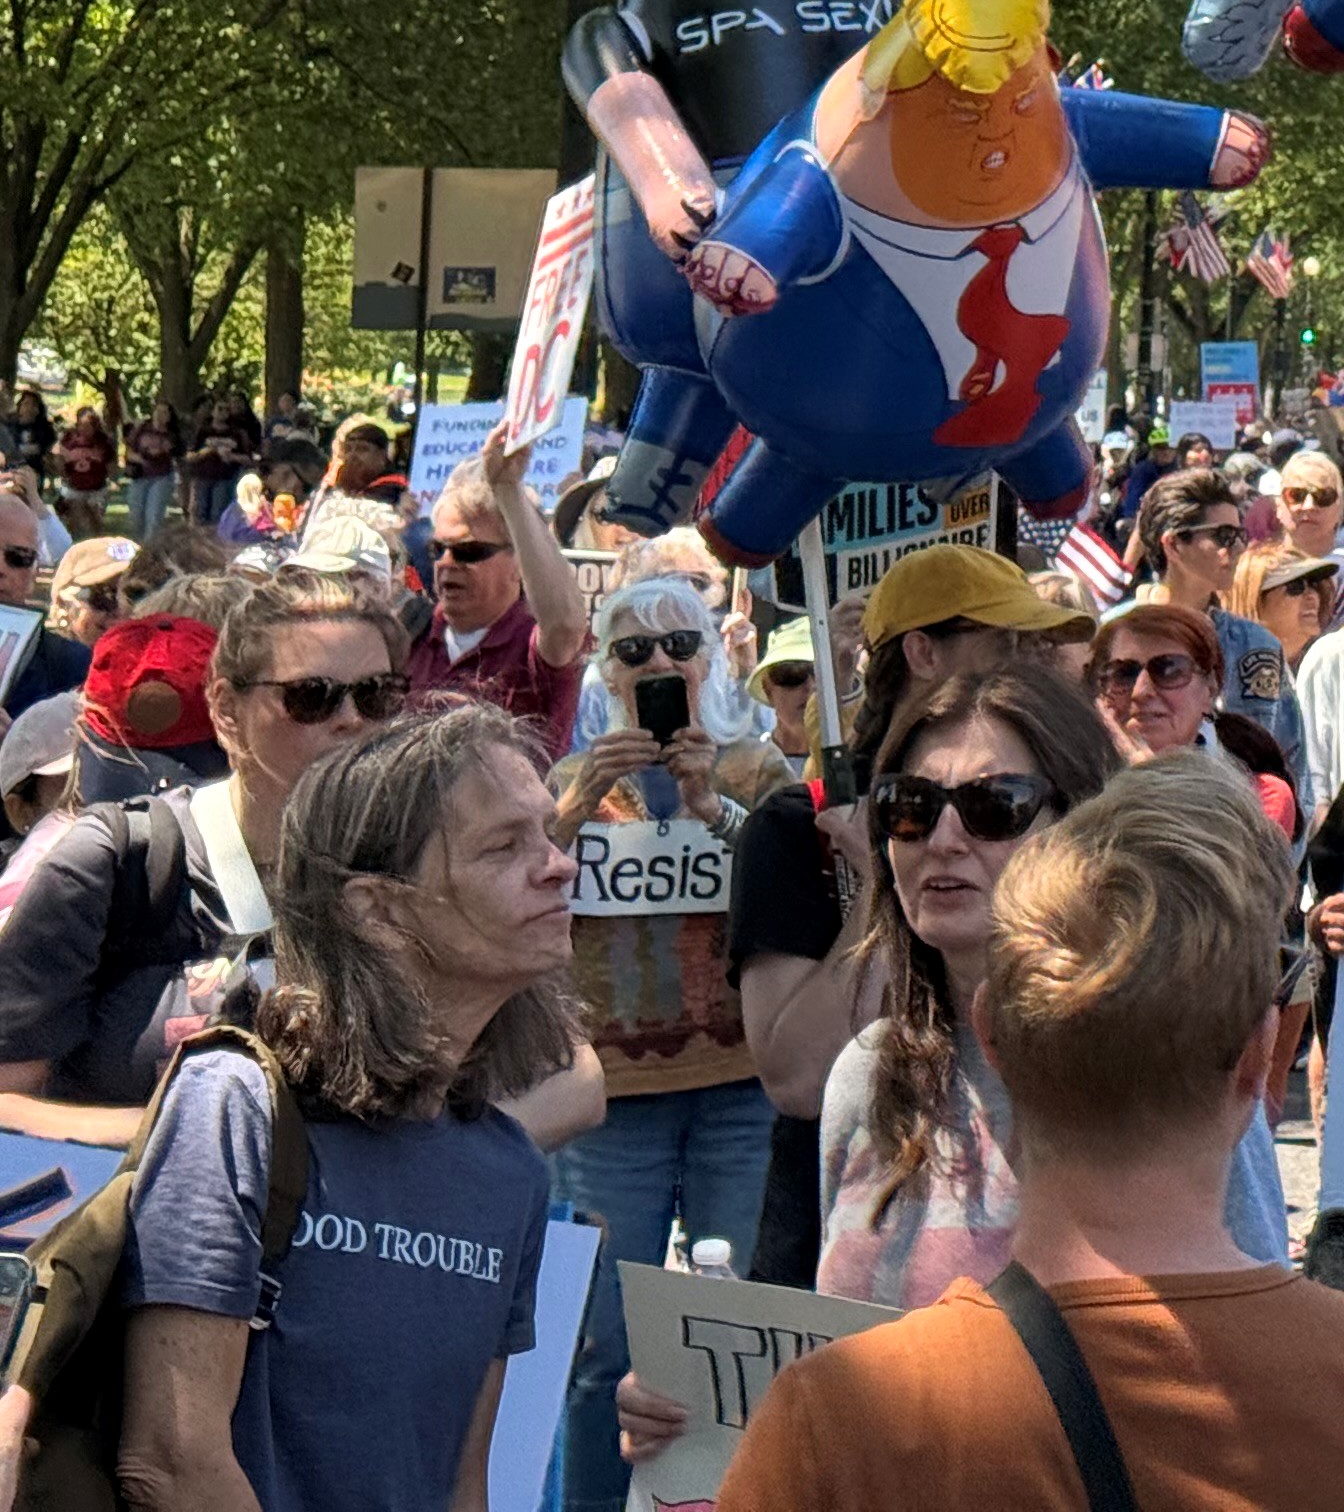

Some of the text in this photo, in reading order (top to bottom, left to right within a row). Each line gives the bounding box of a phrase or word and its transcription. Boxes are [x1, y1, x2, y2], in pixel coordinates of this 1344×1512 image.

[676, 7, 787, 54] SPA
[422, 442, 484, 458] EDUCA
[949, 492, 991, 523] OVER
[571, 833, 733, 903] Resis
[291, 1210, 504, 1284] OOD TROUBLE
